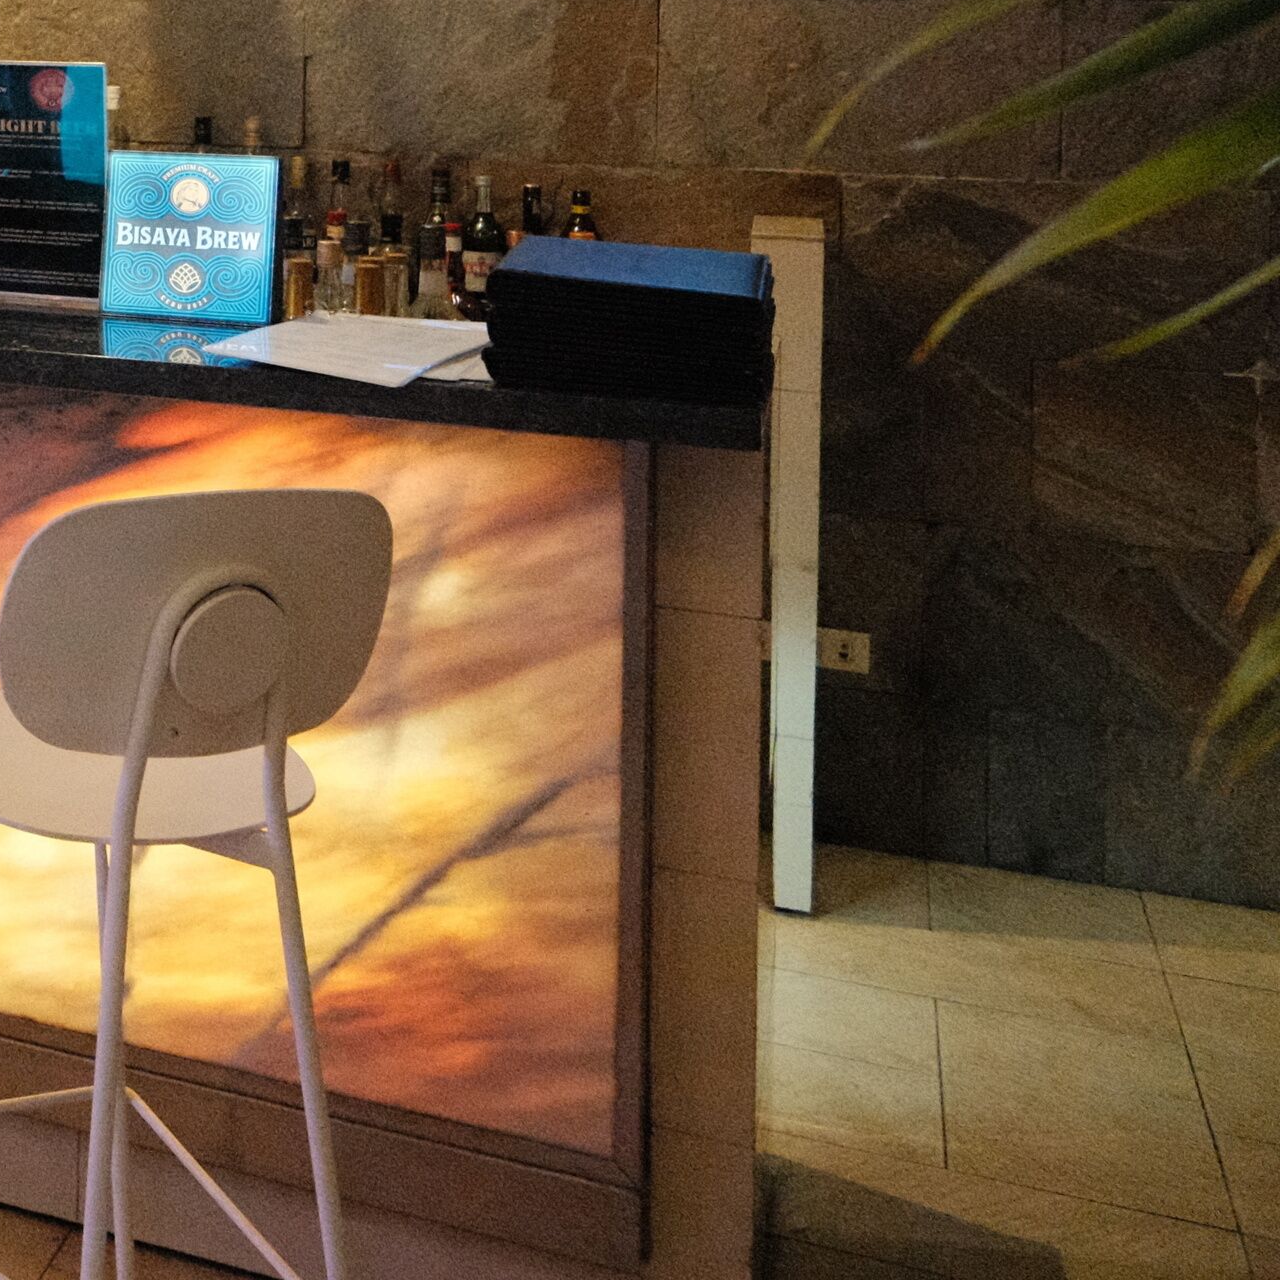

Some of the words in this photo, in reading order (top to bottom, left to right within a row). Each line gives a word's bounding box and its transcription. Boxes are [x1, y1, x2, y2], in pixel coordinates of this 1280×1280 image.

[161, 164, 196, 181] PREMIUM
[197, 166, 220, 184] CRAFT
[116, 222, 191, 247] BISAYA
[195, 225, 261, 251] BREW
[160, 294, 182, 310] CEBU
